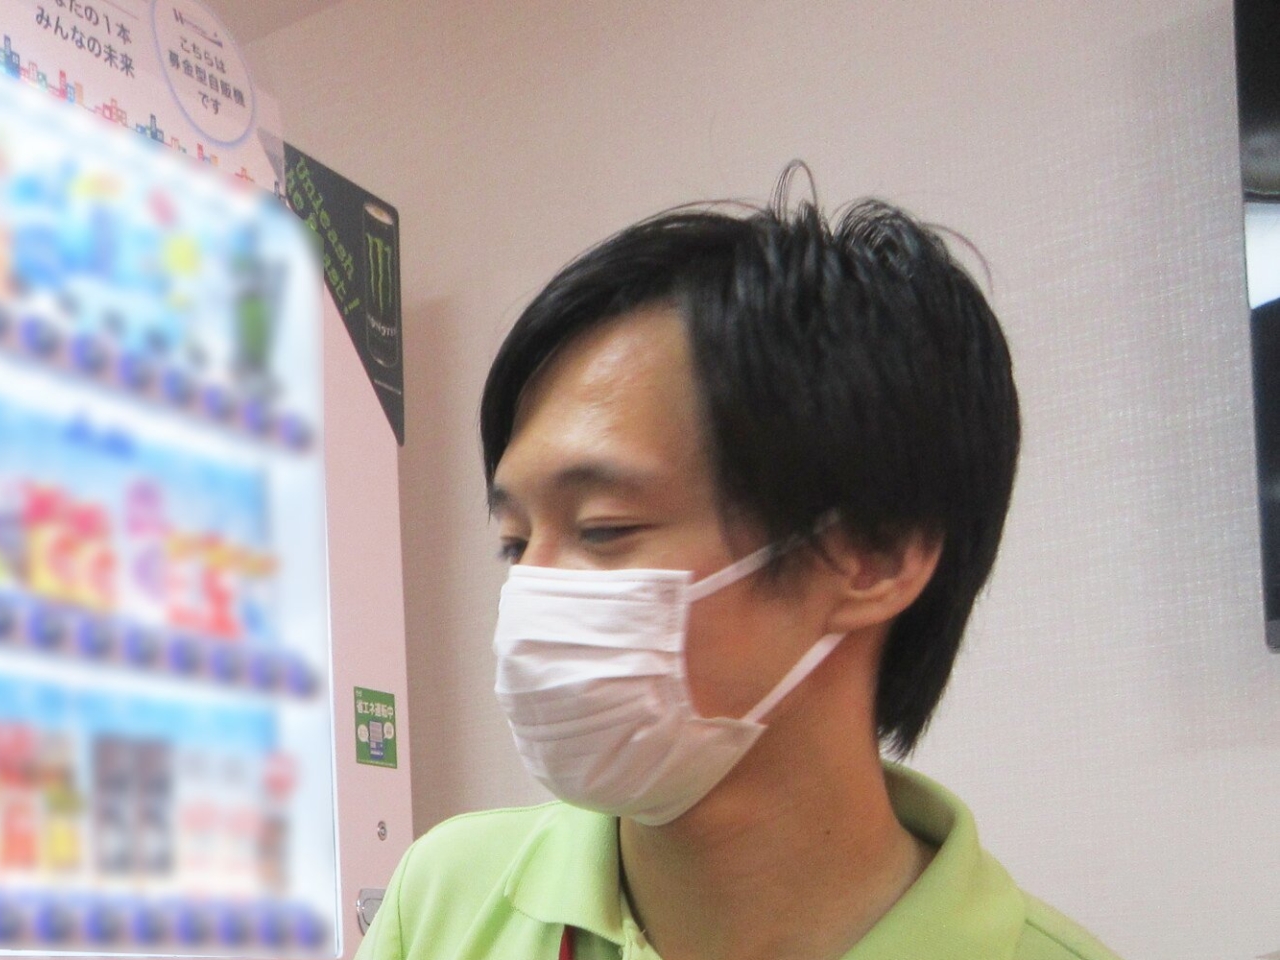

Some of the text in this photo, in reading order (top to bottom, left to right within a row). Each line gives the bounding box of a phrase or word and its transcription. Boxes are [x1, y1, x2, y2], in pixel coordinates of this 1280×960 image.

[36, 6, 135, 78] みんなの未来
[198, 90, 221, 115] です
